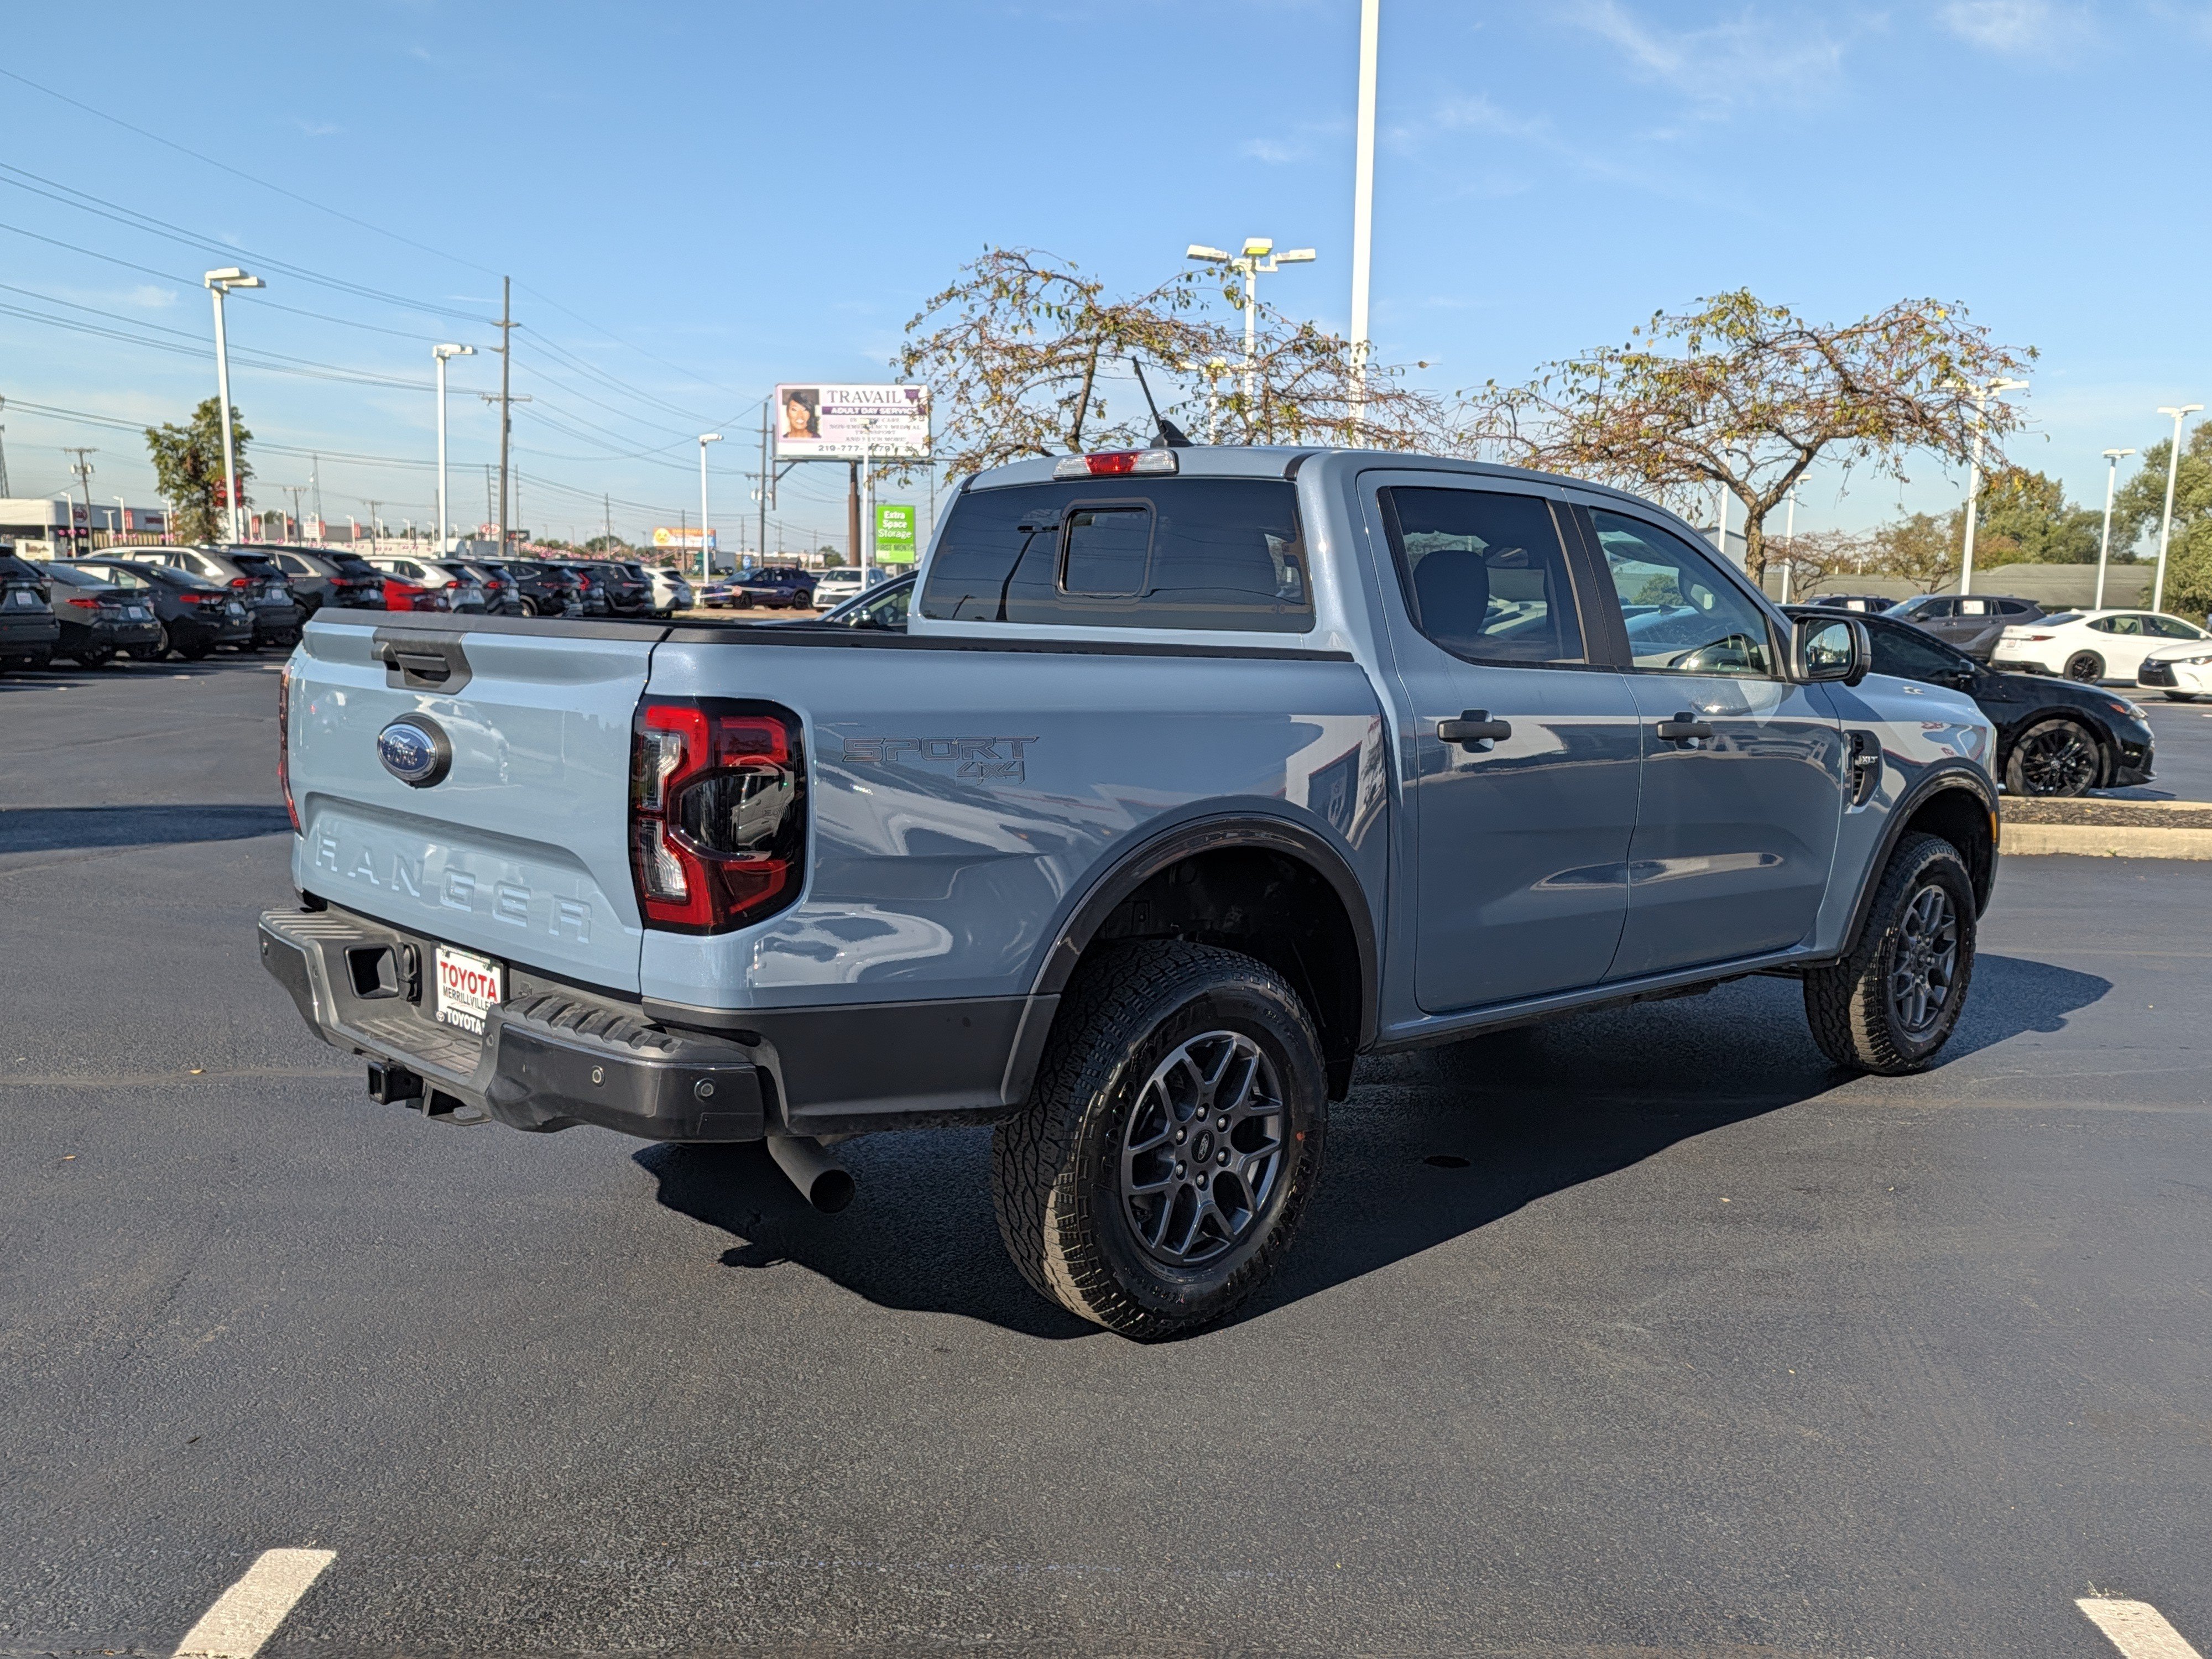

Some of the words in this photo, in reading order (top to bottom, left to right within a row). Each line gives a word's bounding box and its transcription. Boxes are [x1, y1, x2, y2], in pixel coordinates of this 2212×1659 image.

[827, 390, 902, 404] TRAVAIL
[884, 510, 906, 519] Extra
[883, 520, 907, 529] Space
[878, 529, 912, 540] Storage
[842, 737, 1040, 762] SPORT
[1860, 755, 1879, 764] XLT
[315, 830, 592, 943] RANGER
[440, 960, 498, 1003] TOYOTA
[443, 985, 491, 1011] MERRILLVILLE
[446, 1009, 483, 1036] TOYOTA
